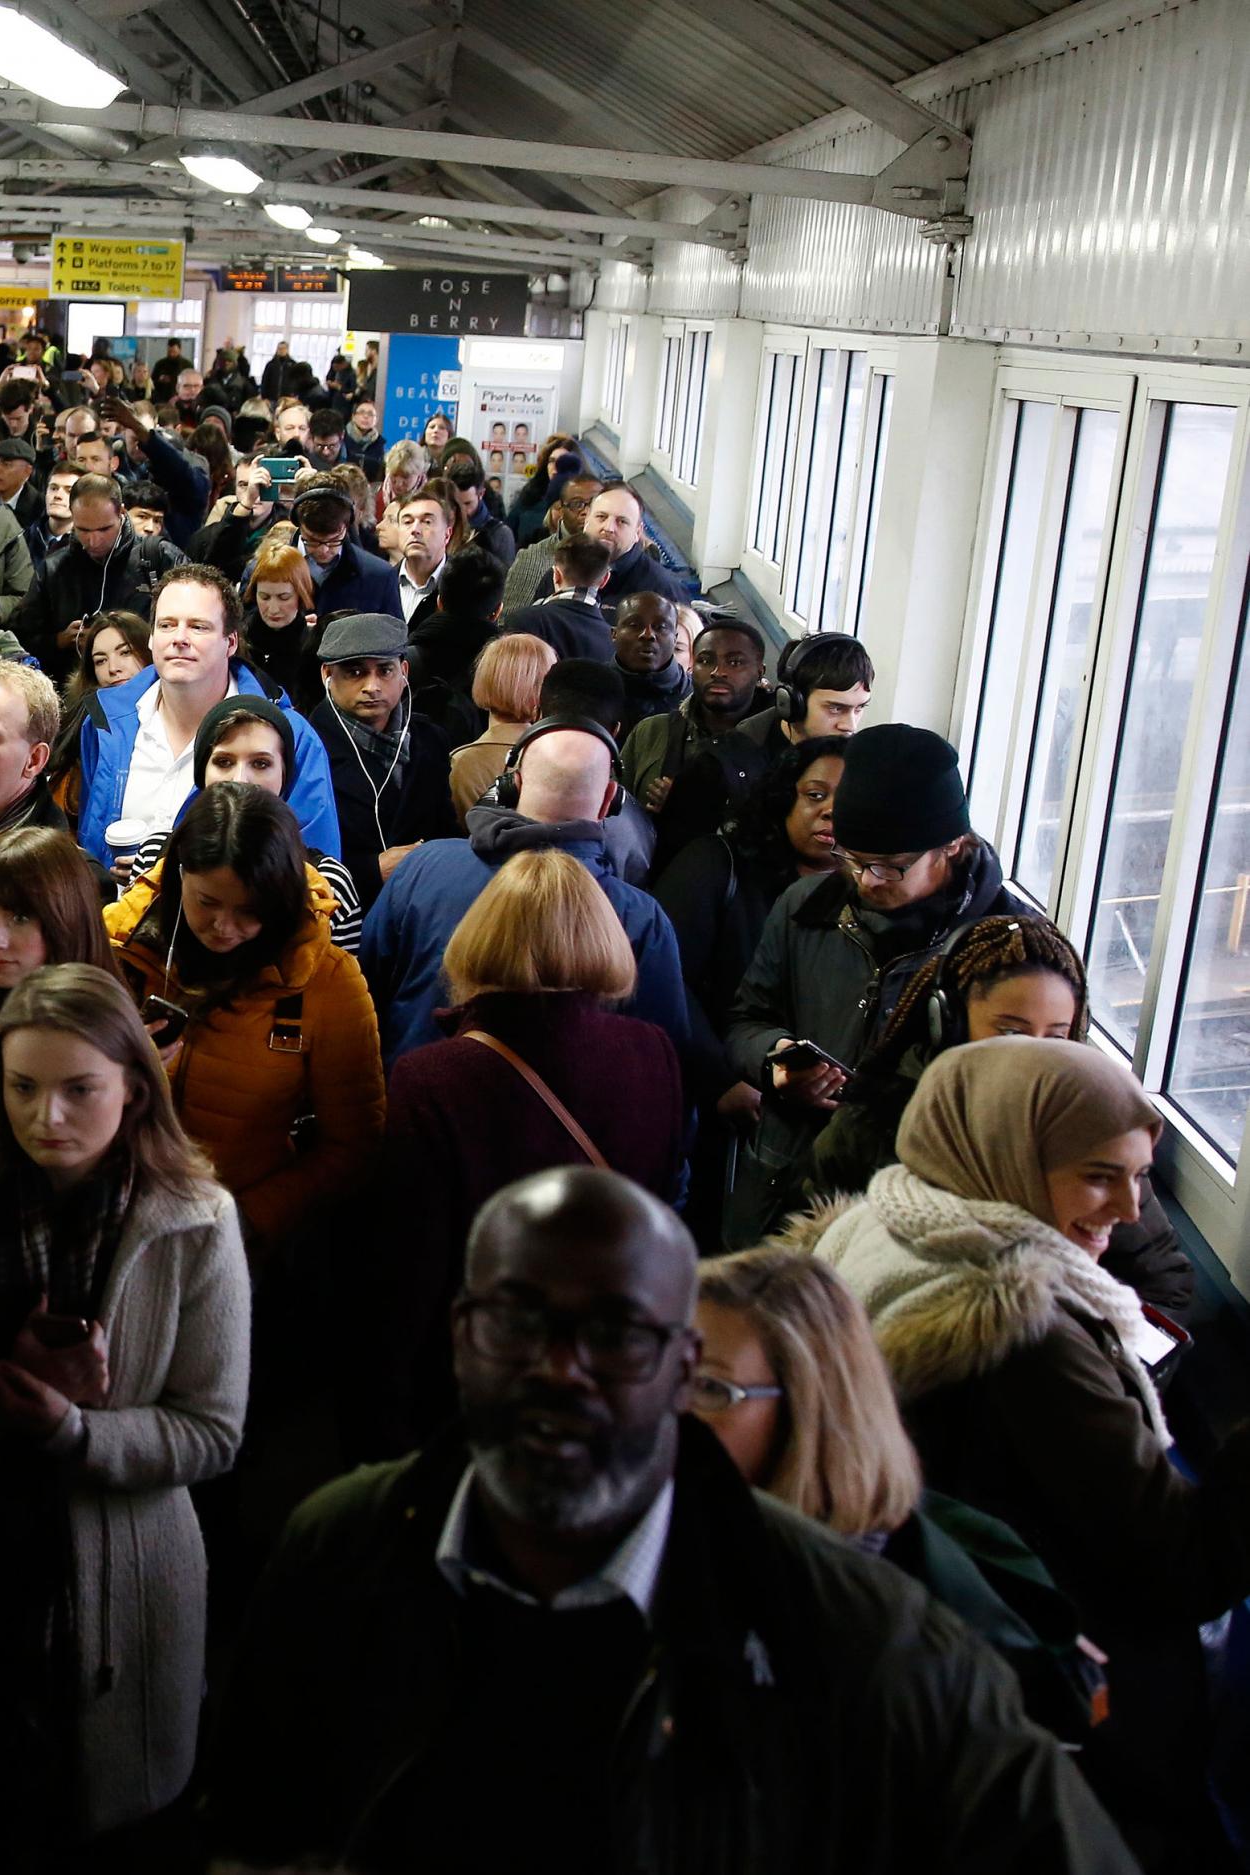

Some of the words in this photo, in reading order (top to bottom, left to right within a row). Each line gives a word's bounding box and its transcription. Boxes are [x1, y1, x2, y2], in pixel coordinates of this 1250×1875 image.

[89, 243, 111, 256] Way
[114, 244, 132, 254] out
[88, 258, 139, 270] Platforms
[141, 260, 148, 270] 7
[151, 260, 162, 271] to
[165, 261, 176, 271] 17
[108, 282, 142, 292] Toilets
[422, 278, 492, 294] ROSE
[449, 298, 462, 312] N
[409, 314, 500, 330] BERRY
[420, 373, 440, 384] EV
[481, 390, 543, 403] Photo-Me
